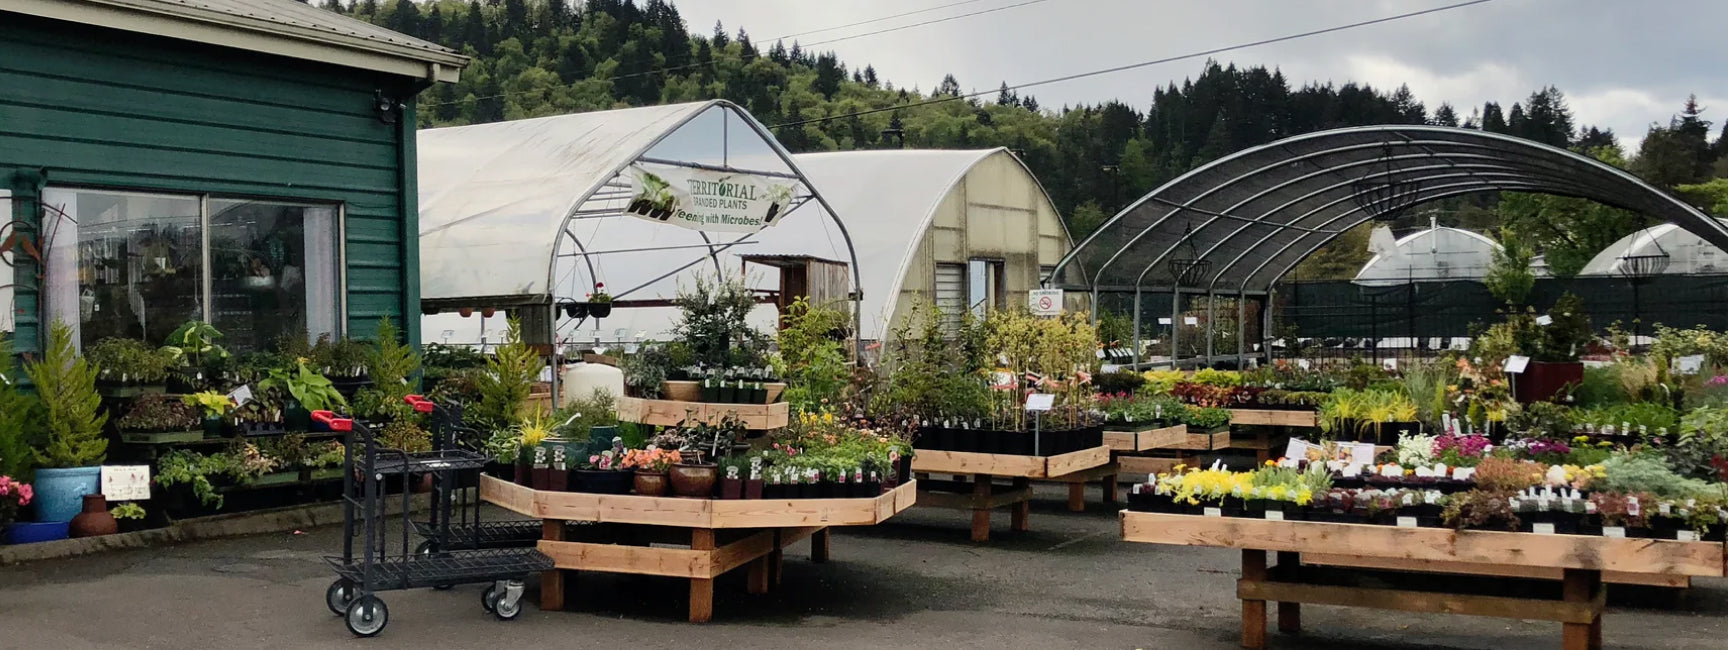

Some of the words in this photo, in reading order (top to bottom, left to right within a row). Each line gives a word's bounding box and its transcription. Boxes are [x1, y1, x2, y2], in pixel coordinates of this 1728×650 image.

[687, 179, 757, 201] TERRITORIAL
[719, 199, 747, 210] PLANTS
[706, 213, 719, 224] with
[721, 214, 763, 225] Microbes!
